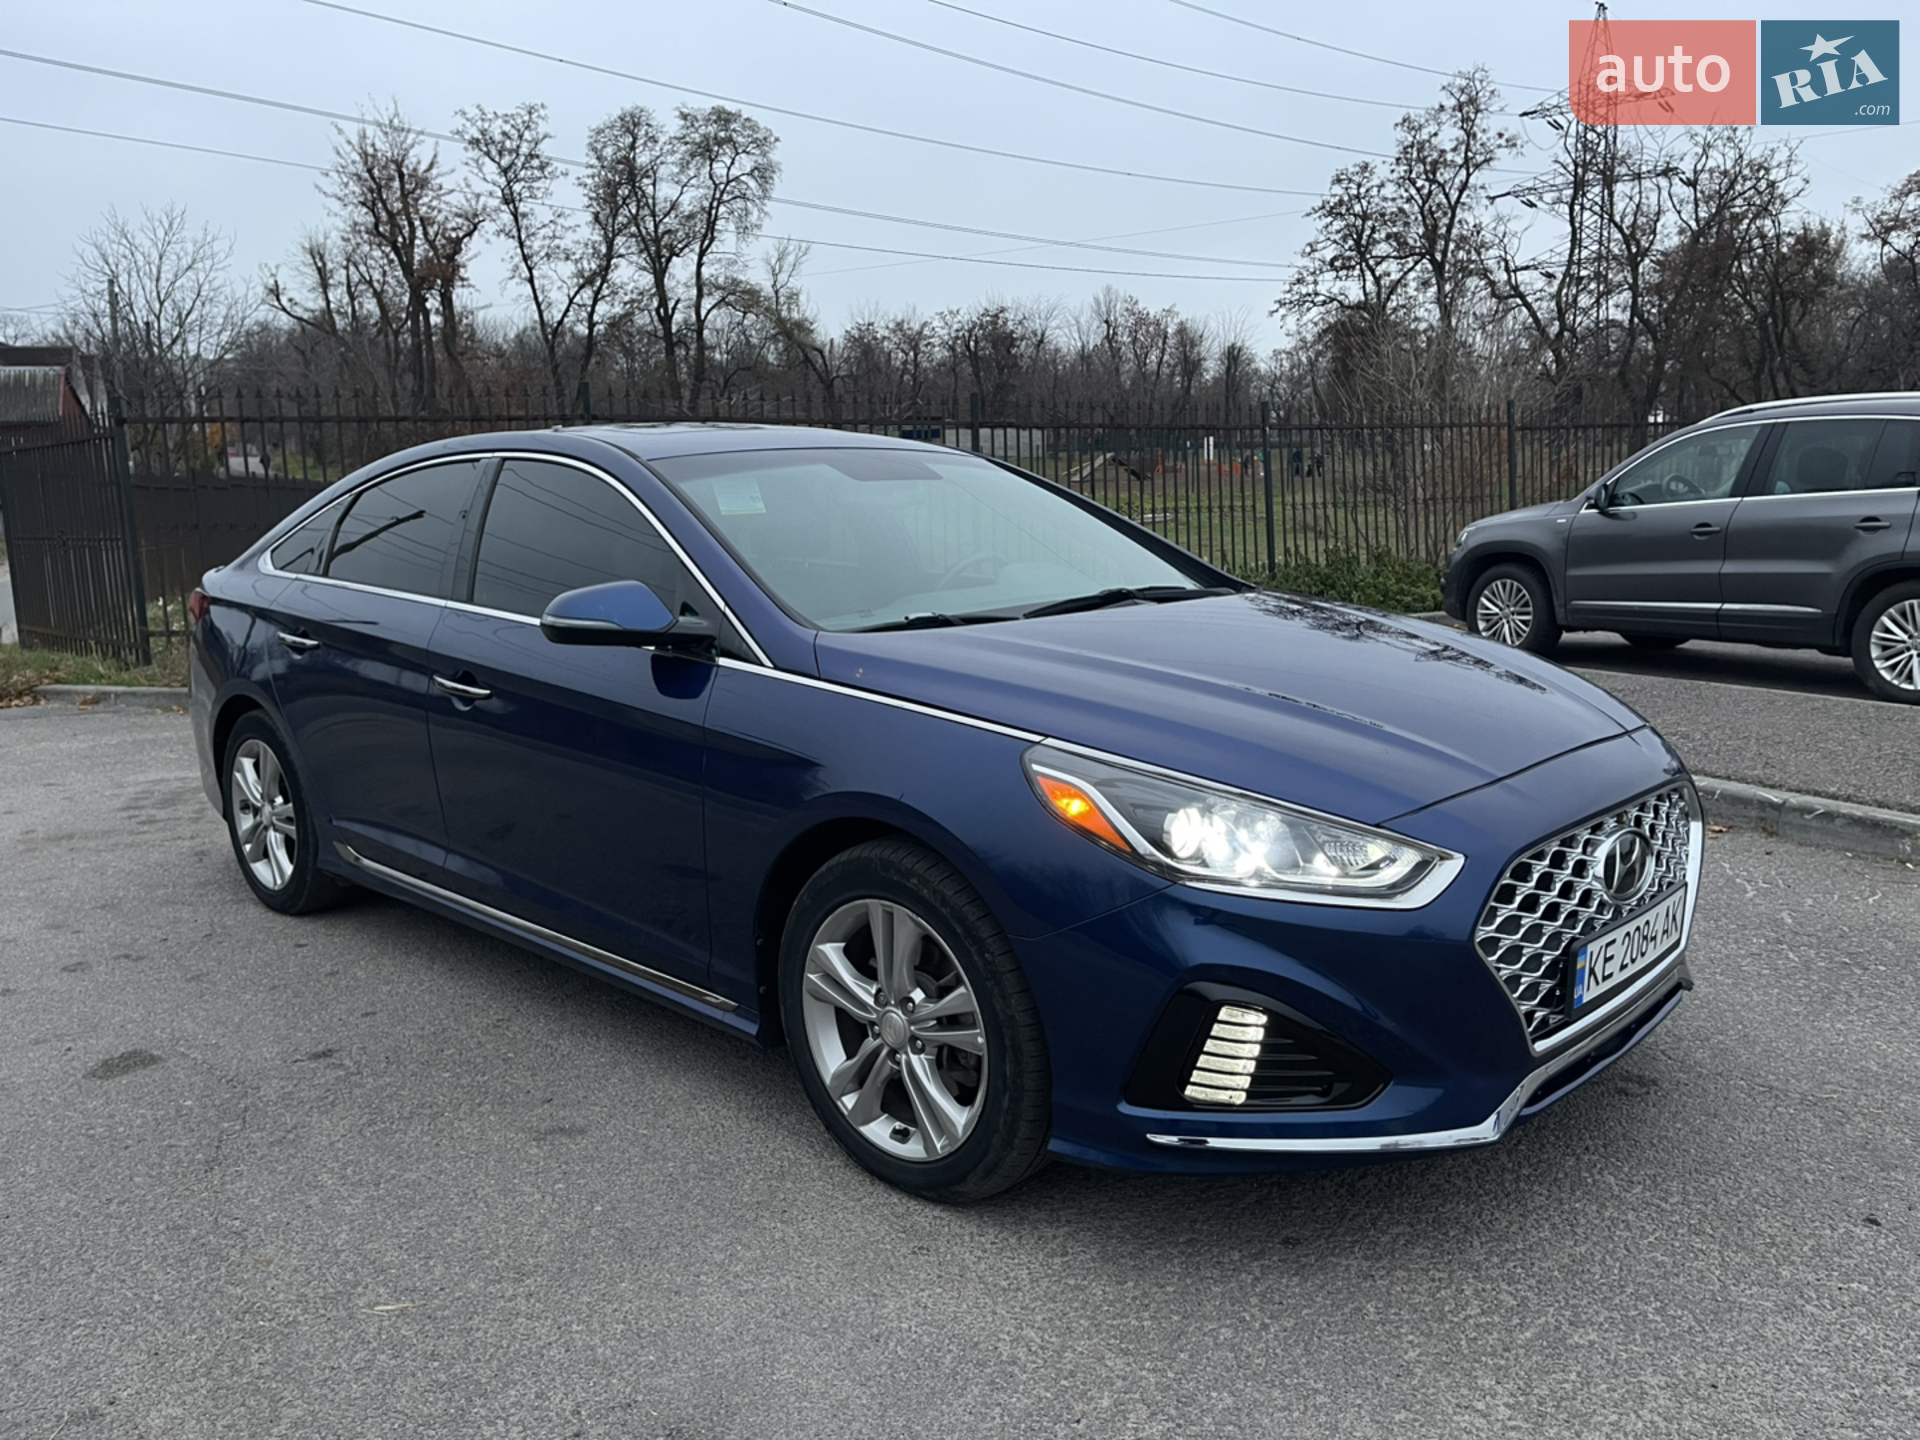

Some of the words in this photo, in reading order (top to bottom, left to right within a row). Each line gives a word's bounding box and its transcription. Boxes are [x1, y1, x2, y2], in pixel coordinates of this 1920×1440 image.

[1587, 938, 1616, 992] KE
[1619, 912, 1659, 973] 2084
[1660, 895, 1682, 944] AK
